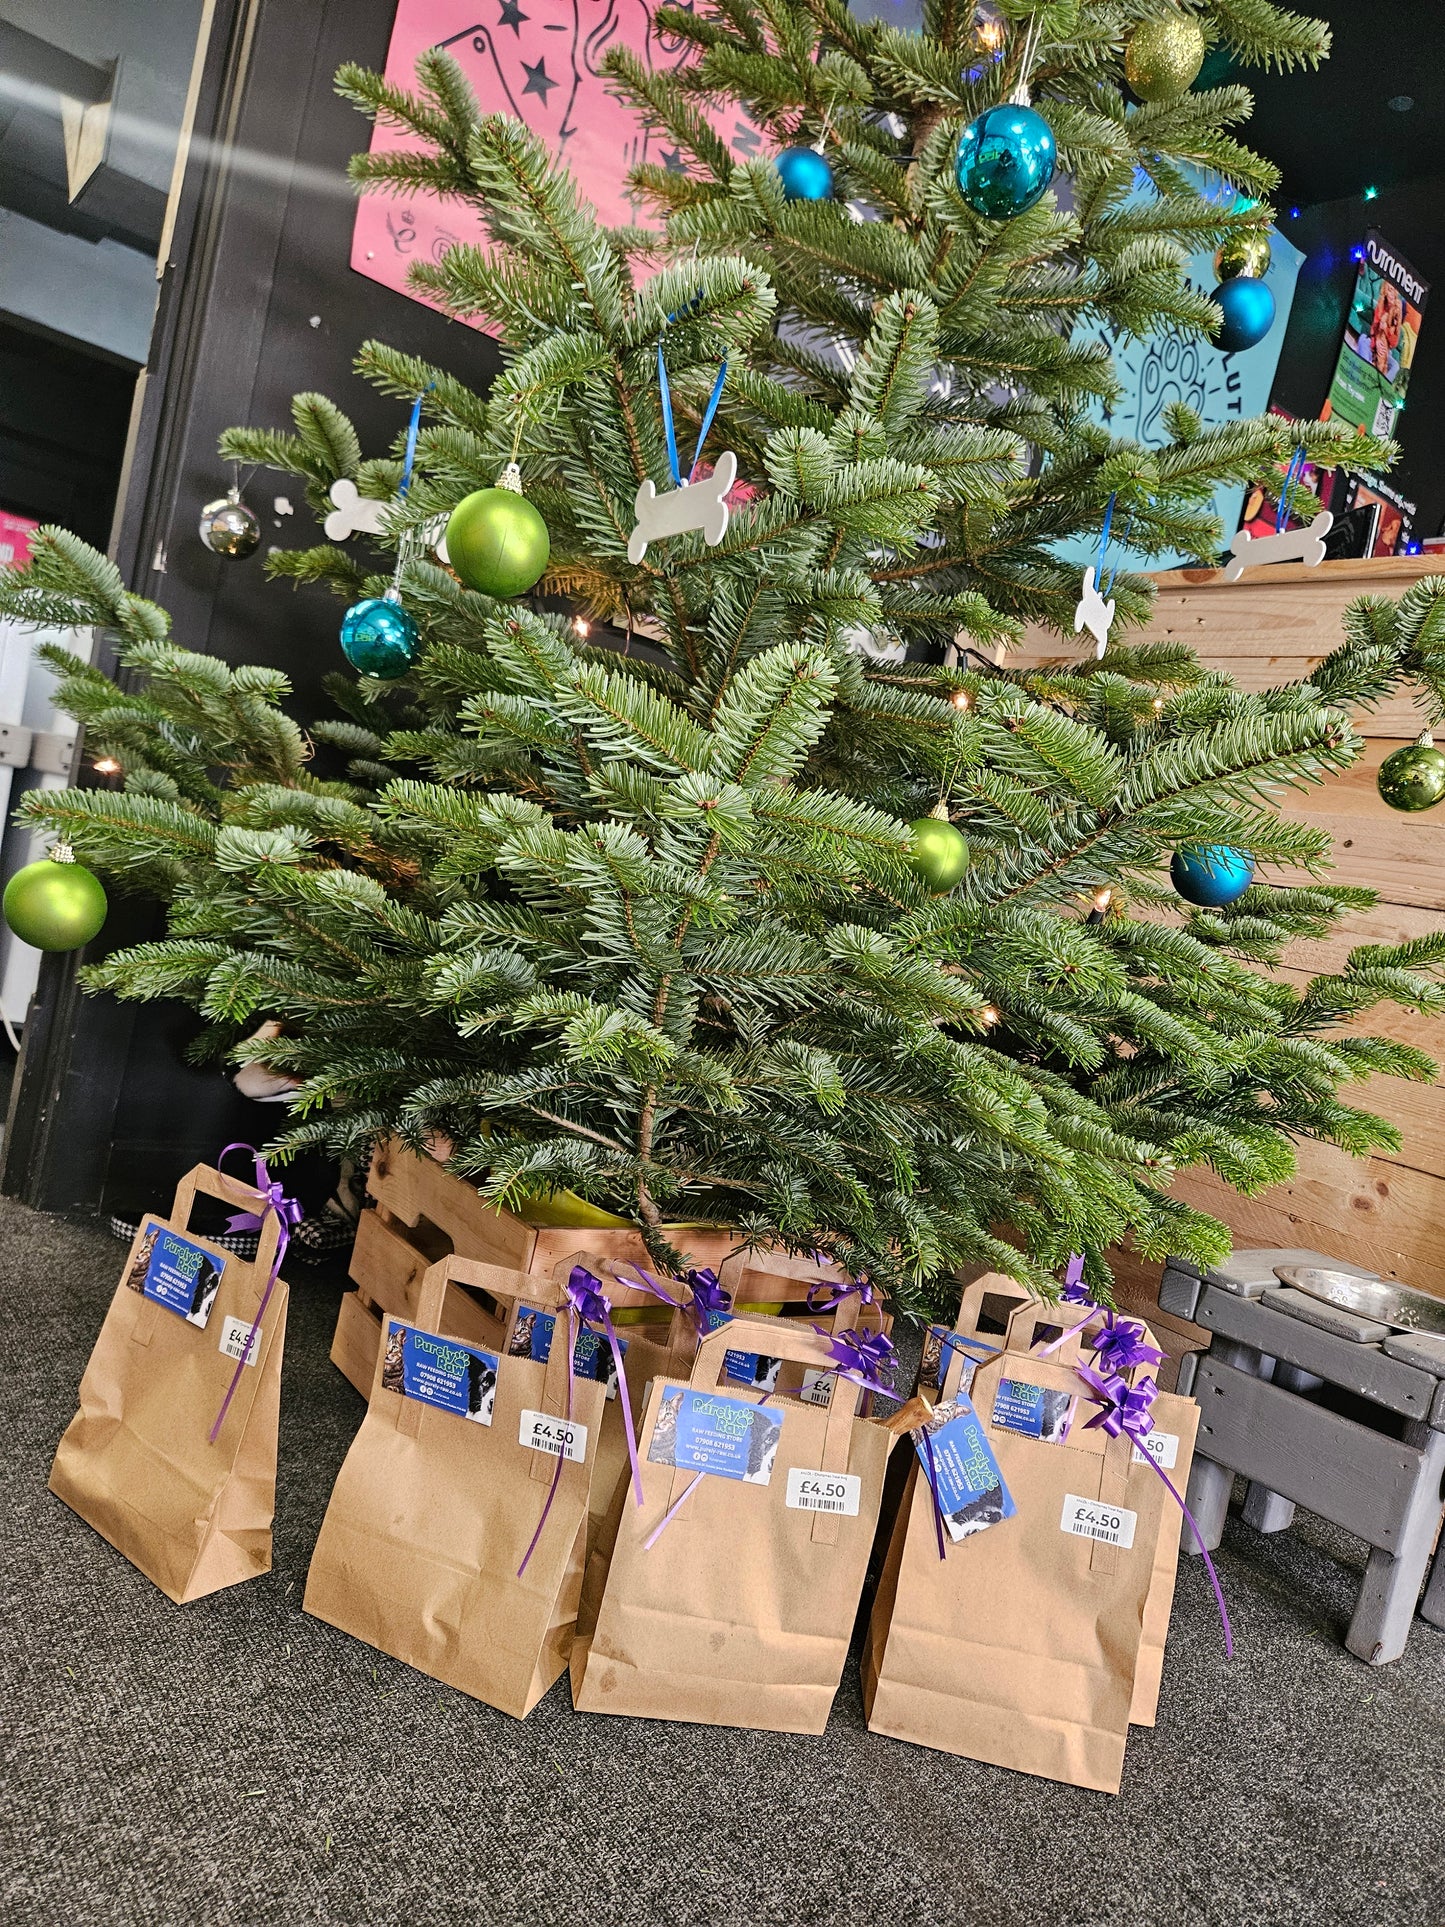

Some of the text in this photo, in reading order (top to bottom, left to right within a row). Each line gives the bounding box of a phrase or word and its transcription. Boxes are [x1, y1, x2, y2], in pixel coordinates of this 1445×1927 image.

[163, 1237, 194, 1265] Purely
[176, 1257, 198, 1278] Raw
[229, 1329, 255, 1348] £4.50
[415, 1335, 457, 1362] Purely
[574, 1345, 593, 1358] aw
[575, 1354, 591, 1362] STORE
[416, 1362, 462, 1382] RAW FEEDING STORE
[437, 1355, 465, 1376] Raw
[573, 1359, 584, 1367] 953
[412, 1376, 463, 1398] www.purely-raw.co.uk
[419, 1371, 457, 1389] 07908 621953
[813, 1381, 831, 1393] £4
[1001, 1396, 1021, 1405] FEEDING
[1011, 1385, 1040, 1403] Raw
[692, 1399, 740, 1421] Purely
[994, 1409, 1036, 1423] .purely-raw.co.uk
[1010, 1405, 1030, 1415] 621953
[533, 1423, 573, 1444] £4.50
[716, 1417, 748, 1436] Raw
[695, 1437, 735, 1451] 07908 621953
[704, 1430, 726, 1439] FEEDING
[726, 1435, 743, 1443] STORE
[1147, 1439, 1164, 1452] 50
[964, 1425, 989, 1474] Purely
[943, 1449, 955, 1468] 07908
[951, 1468, 964, 1491] 621953
[949, 1440, 973, 1492] RAW FEEDING STORE
[965, 1458, 984, 1491] Raw
[799, 1481, 845, 1497] £4.50
[1075, 1509, 1120, 1529] £4.50
